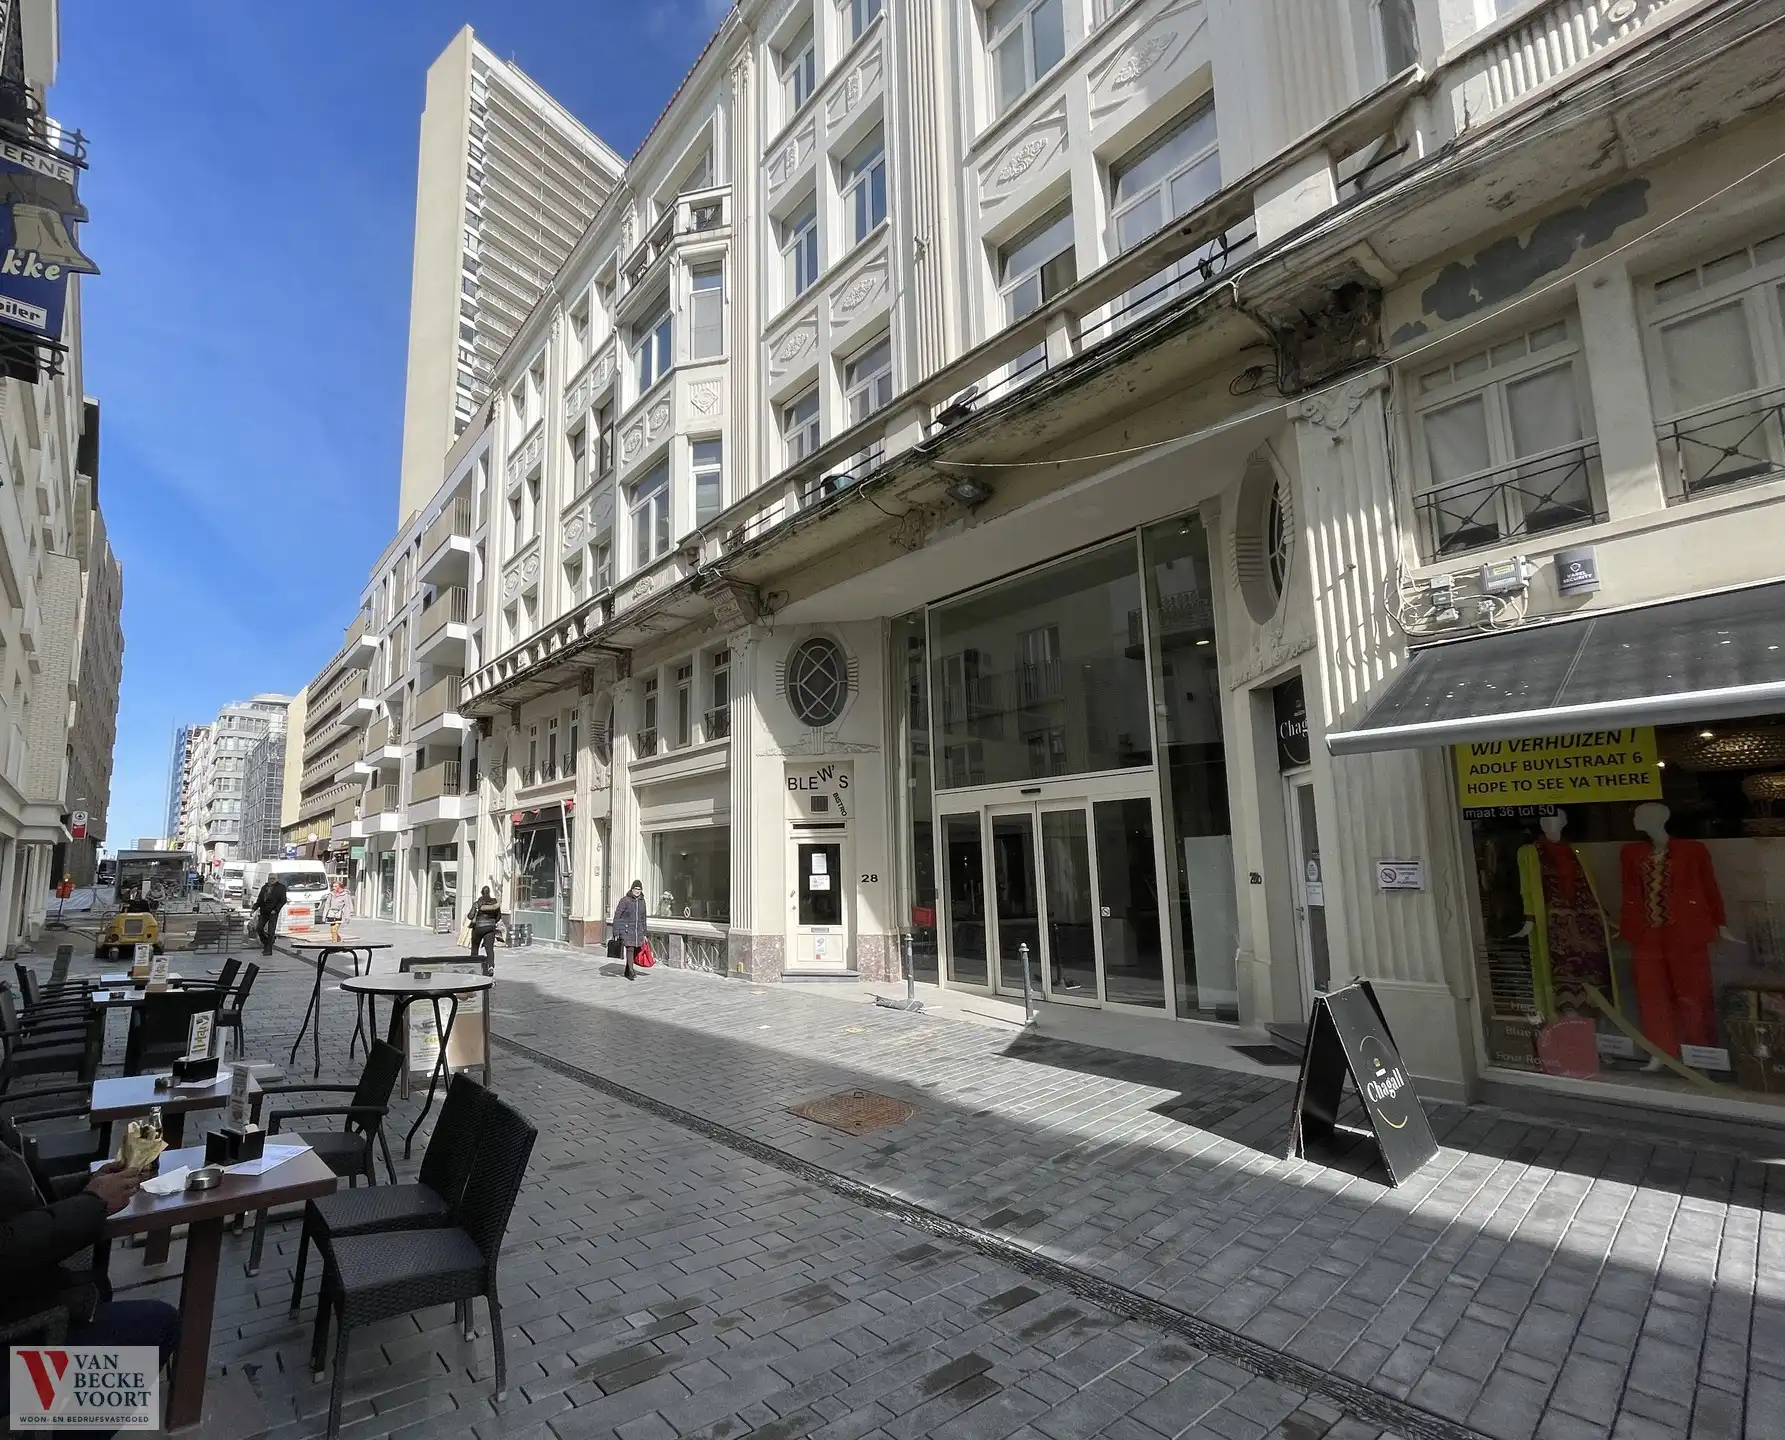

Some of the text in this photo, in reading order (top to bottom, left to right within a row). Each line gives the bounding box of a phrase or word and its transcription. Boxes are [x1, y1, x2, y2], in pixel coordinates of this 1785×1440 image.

[0, 141, 71, 182] ERNE
[1, 249, 60, 280] kke
[1471, 728, 1636, 756] WIJ VERHUIZEN !
[1469, 752, 1643, 776] ADOLF BUYLSTRAAT 6
[1467, 772, 1651, 794] HOPE TO SEE YA THERE
[833, 792, 848, 817] BISTRO
[1465, 808, 1496, 819] maat
[1499, 806, 1514, 817] 36
[1538, 804, 1555, 815] 50
[861, 874, 878, 882] 28
[1367, 1068, 1404, 1102] Chagall
